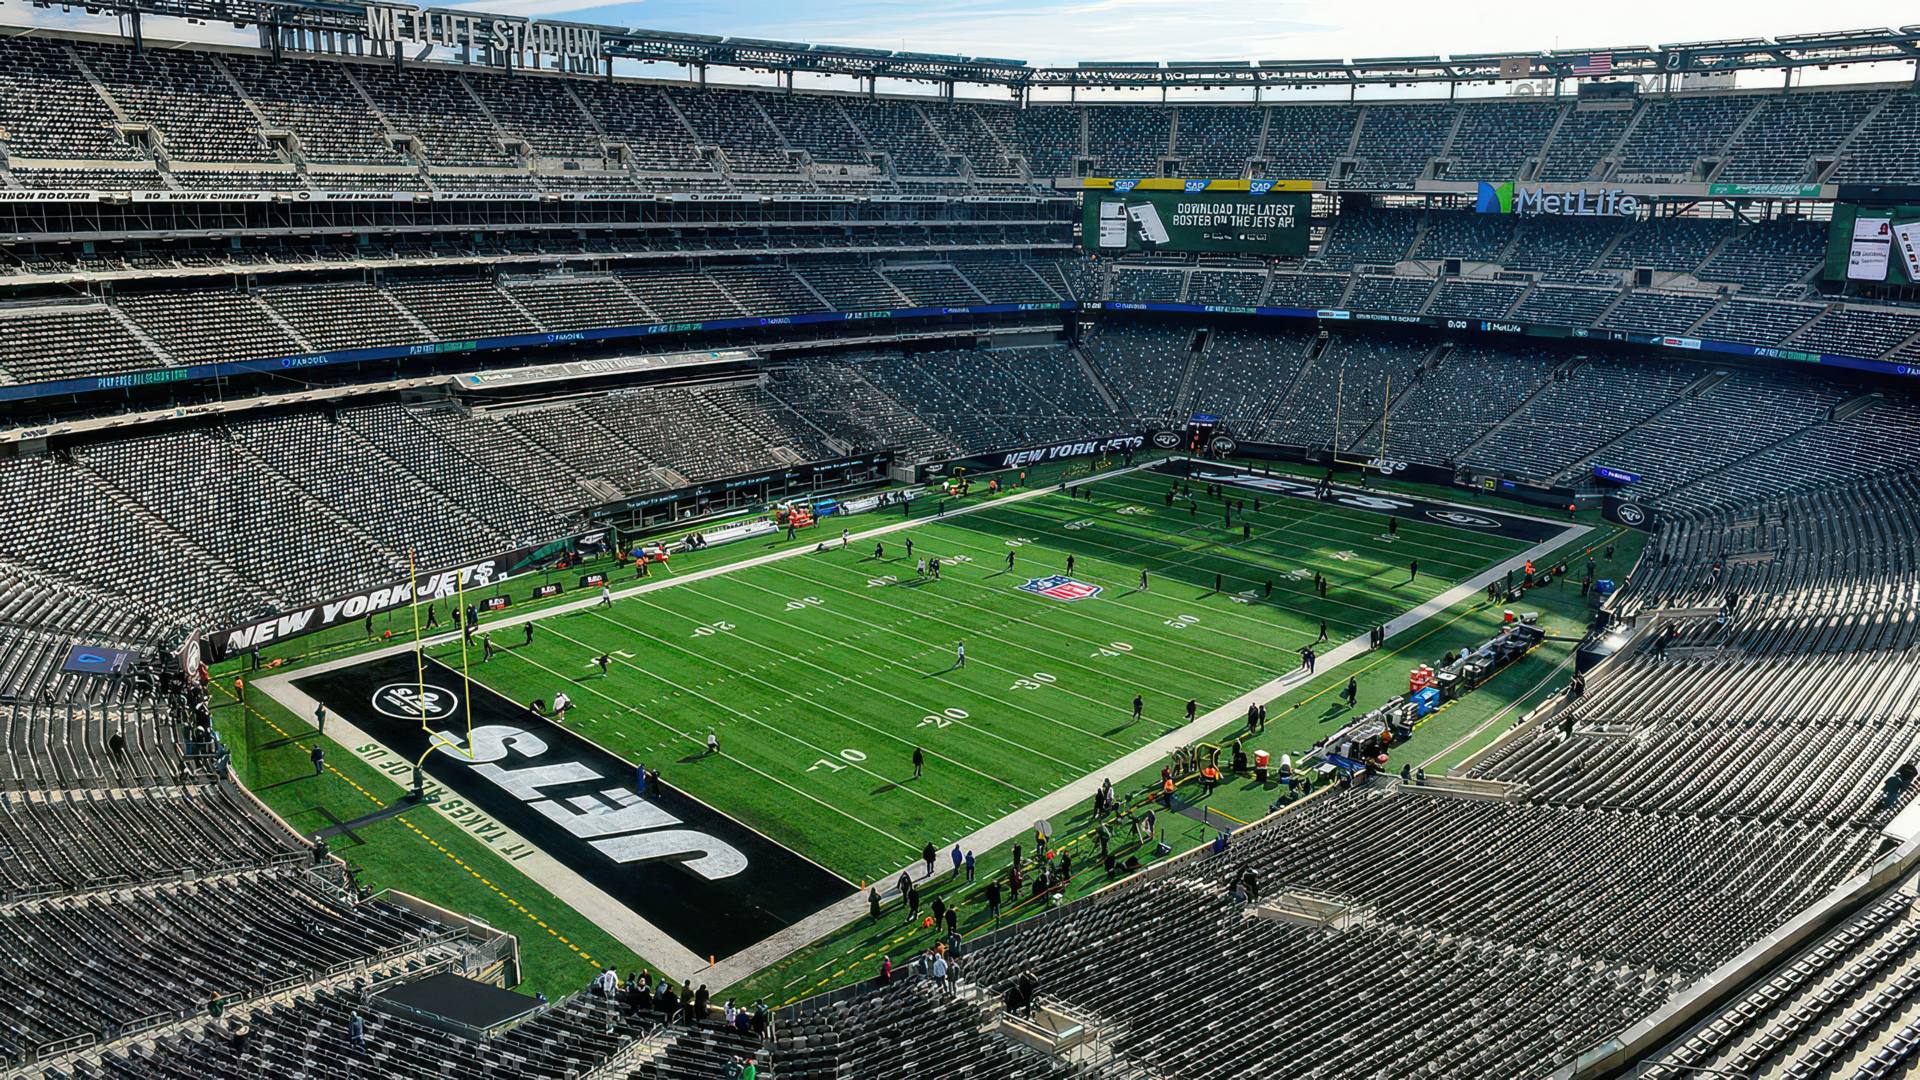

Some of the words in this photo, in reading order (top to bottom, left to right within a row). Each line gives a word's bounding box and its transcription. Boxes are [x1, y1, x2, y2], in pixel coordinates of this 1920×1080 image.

[366, 5, 482, 49] METLIFE
[493, 19, 600, 60] STADIUM
[1185, 182, 1205, 192] SAP
[1250, 182, 1270, 193] SAP
[1177, 203, 1232, 215] DOWNLOAD
[1236, 204, 1255, 215] THE
[1257, 204, 1295, 216] LATEST
[1517, 187, 1637, 216] MetLife
[1230, 215, 1250, 227] THE
[1252, 216, 1275, 228] JETS
[1002, 448, 1047, 467] NEW
[226, 608, 315, 657] NEW
[321, 580, 417, 624] YORK
[417, 559, 497, 599] JETS
[1164, 614, 1200, 629] 50
[1098, 641, 1134, 658] 40
[1014, 672, 1057, 691] 30
[922, 707, 969, 729] 20
[355, 743, 389, 758] US
[378, 760, 412, 776] OF
[815, 748, 867, 774] 10
[428, 725, 748, 880] JETS
[439, 800, 507, 843] TAKES
[500, 844, 534, 861] IT
